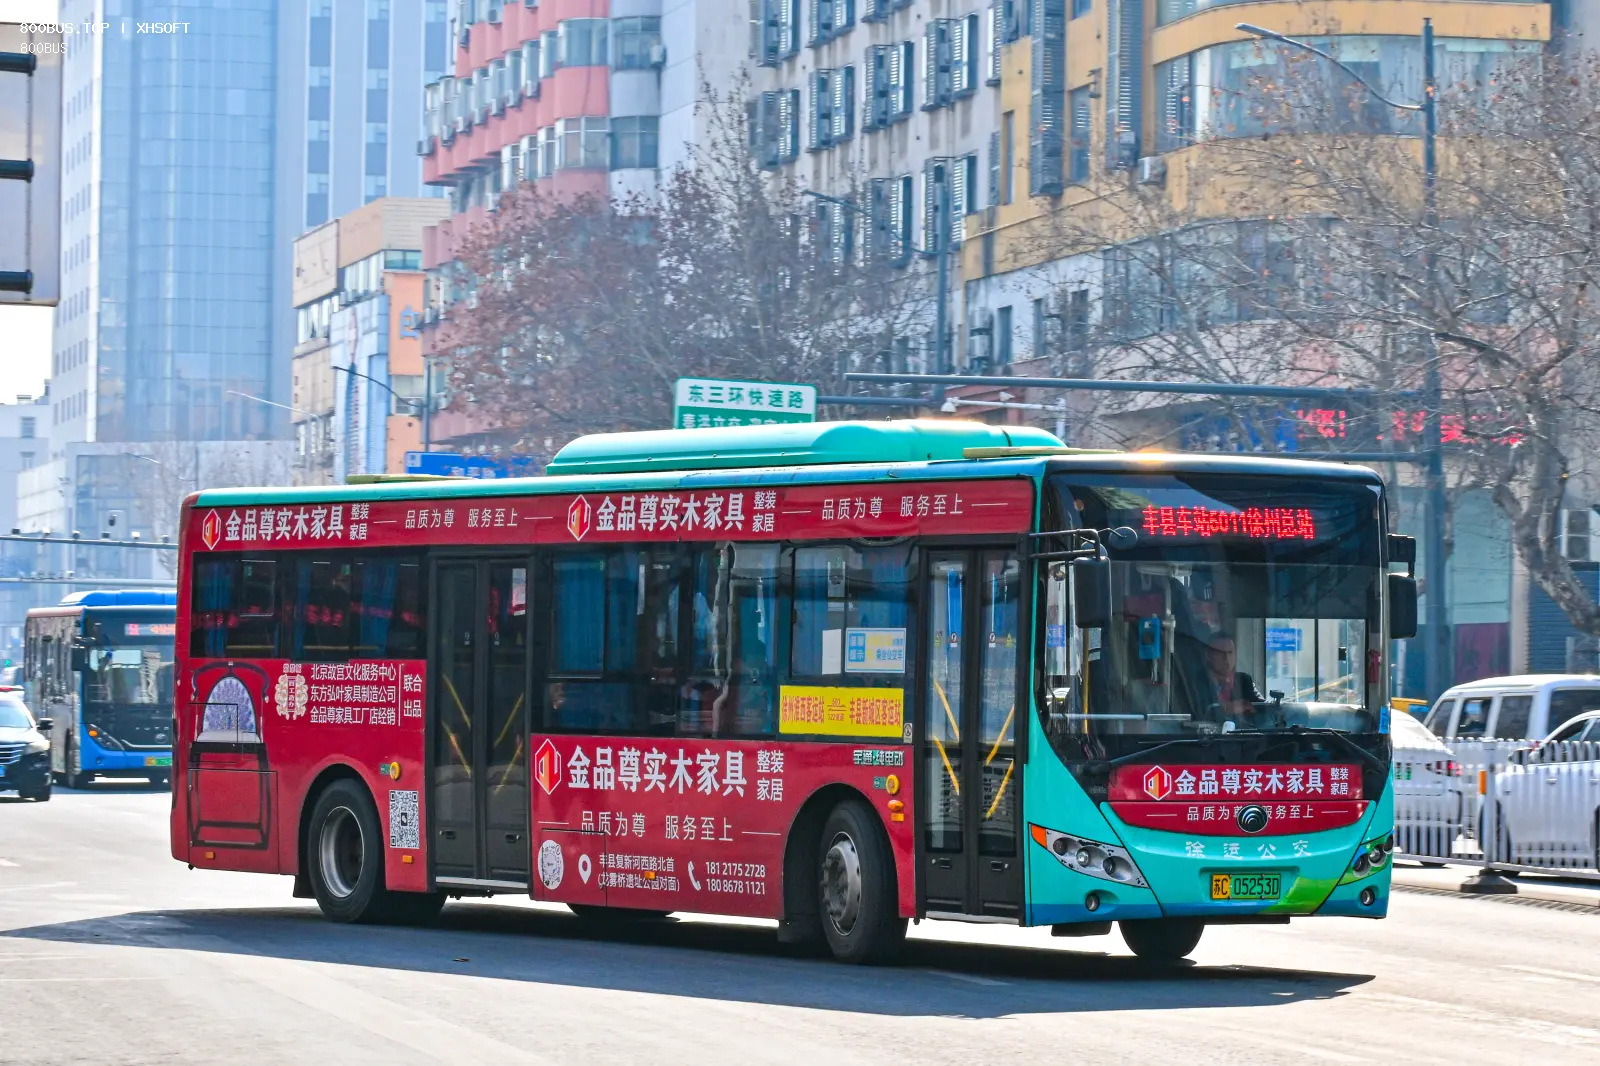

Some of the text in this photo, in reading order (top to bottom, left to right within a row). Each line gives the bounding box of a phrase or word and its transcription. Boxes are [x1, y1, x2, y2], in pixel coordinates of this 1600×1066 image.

[688, 384, 804, 409] 东三环快速路
[753, 490, 777, 510] 整装
[821, 492, 964, 521] 品质为尊 服务至上
[350, 502, 370, 521] 整装
[404, 506, 519, 529] 品质为尊 服务至上
[596, 491, 744, 533] 金品尊实木家具
[225, 504, 344, 542] 金品尊实木家具
[349, 522, 368, 541] 家居
[752, 512, 775, 533] 家居
[310, 663, 397, 682] 北京故宫文化服务中心
[310, 684, 396, 704] 东方弘叶家具制造公司
[403, 674, 423, 693] 联合
[310, 705, 396, 726] 金品尊家具工厂店经销
[403, 700, 422, 718] 出品
[567, 745, 747, 797] 金品尊实木家具
[757, 750, 784, 773] 整装
[1175, 768, 1324, 796] 金品尊实木家具
[1330, 767, 1349, 781] 整装
[757, 778, 784, 802] 家居
[1330, 783, 1348, 796] 家居
[581, 810, 734, 842] 品质为尊 服务至上
[1185, 840, 1312, 860] 徐运公交
[599, 853, 675, 873] 丰县复新河西路北首
